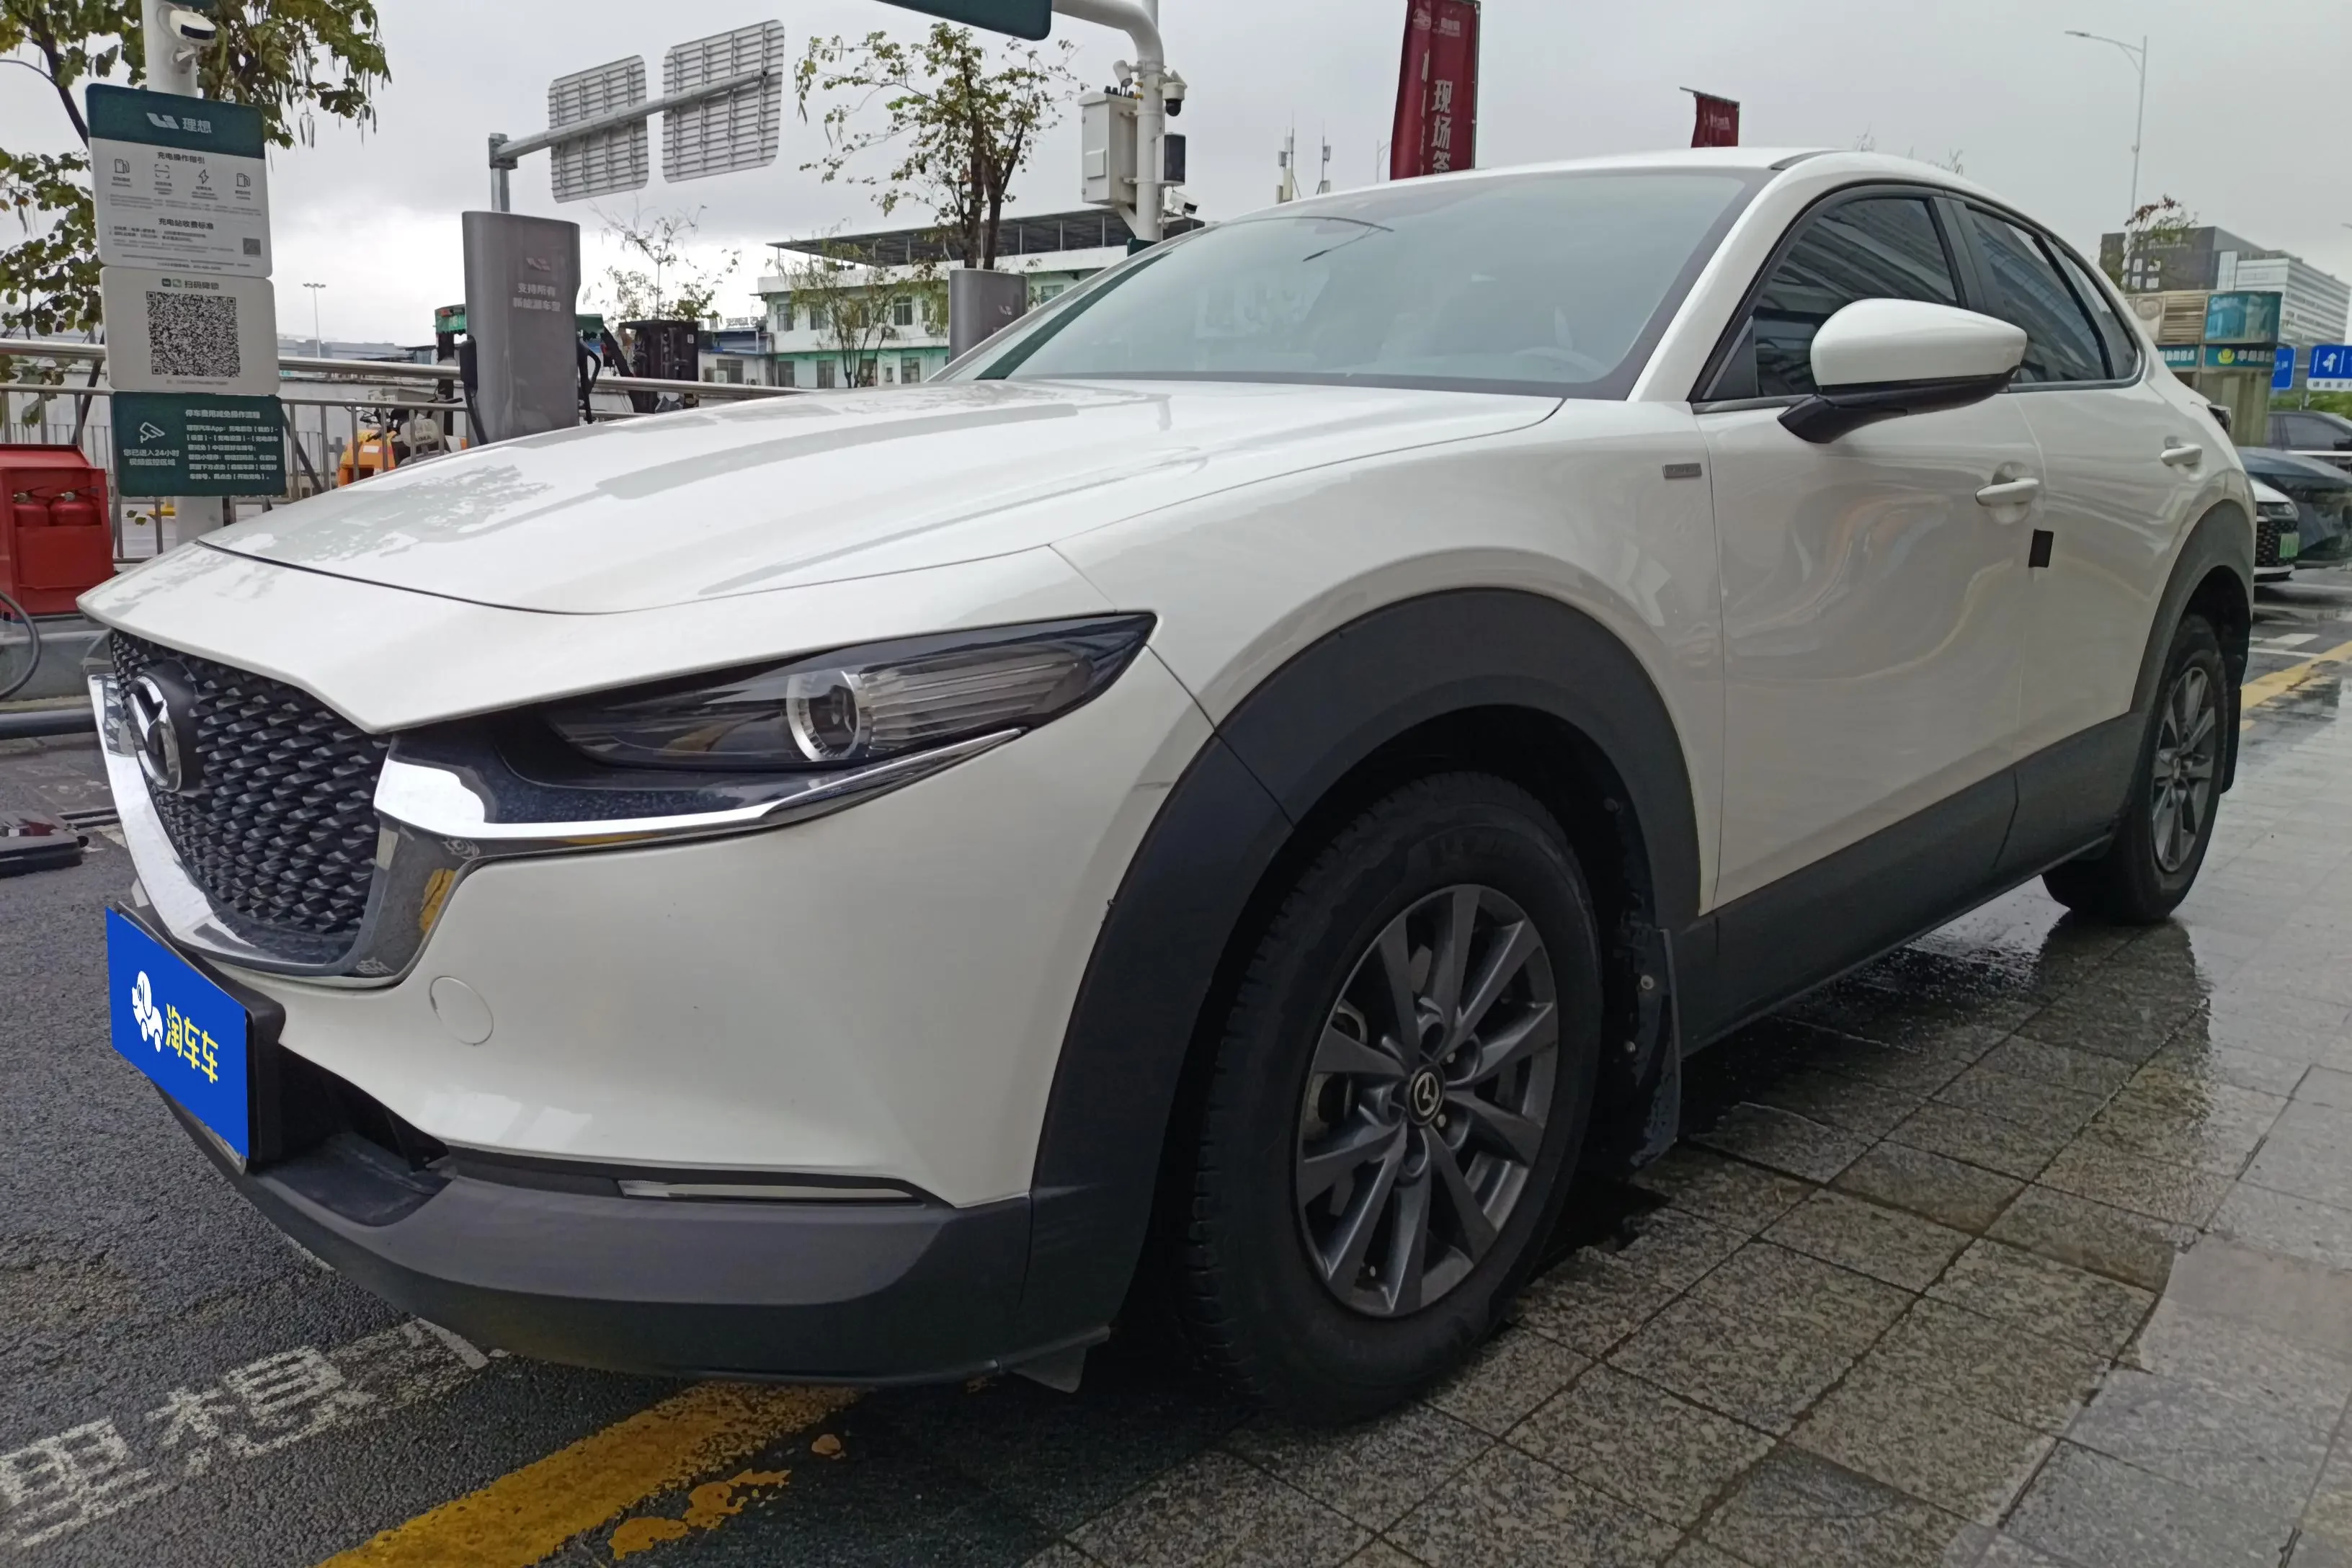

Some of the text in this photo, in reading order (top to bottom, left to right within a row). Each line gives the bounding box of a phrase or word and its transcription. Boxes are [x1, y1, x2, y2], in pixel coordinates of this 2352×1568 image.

[182, 117, 212, 133] 理想
[157, 151, 205, 164] 充电操作指引
[158, 218, 214, 230] 充电站收费标准
[518, 282, 556, 296] 支持所有
